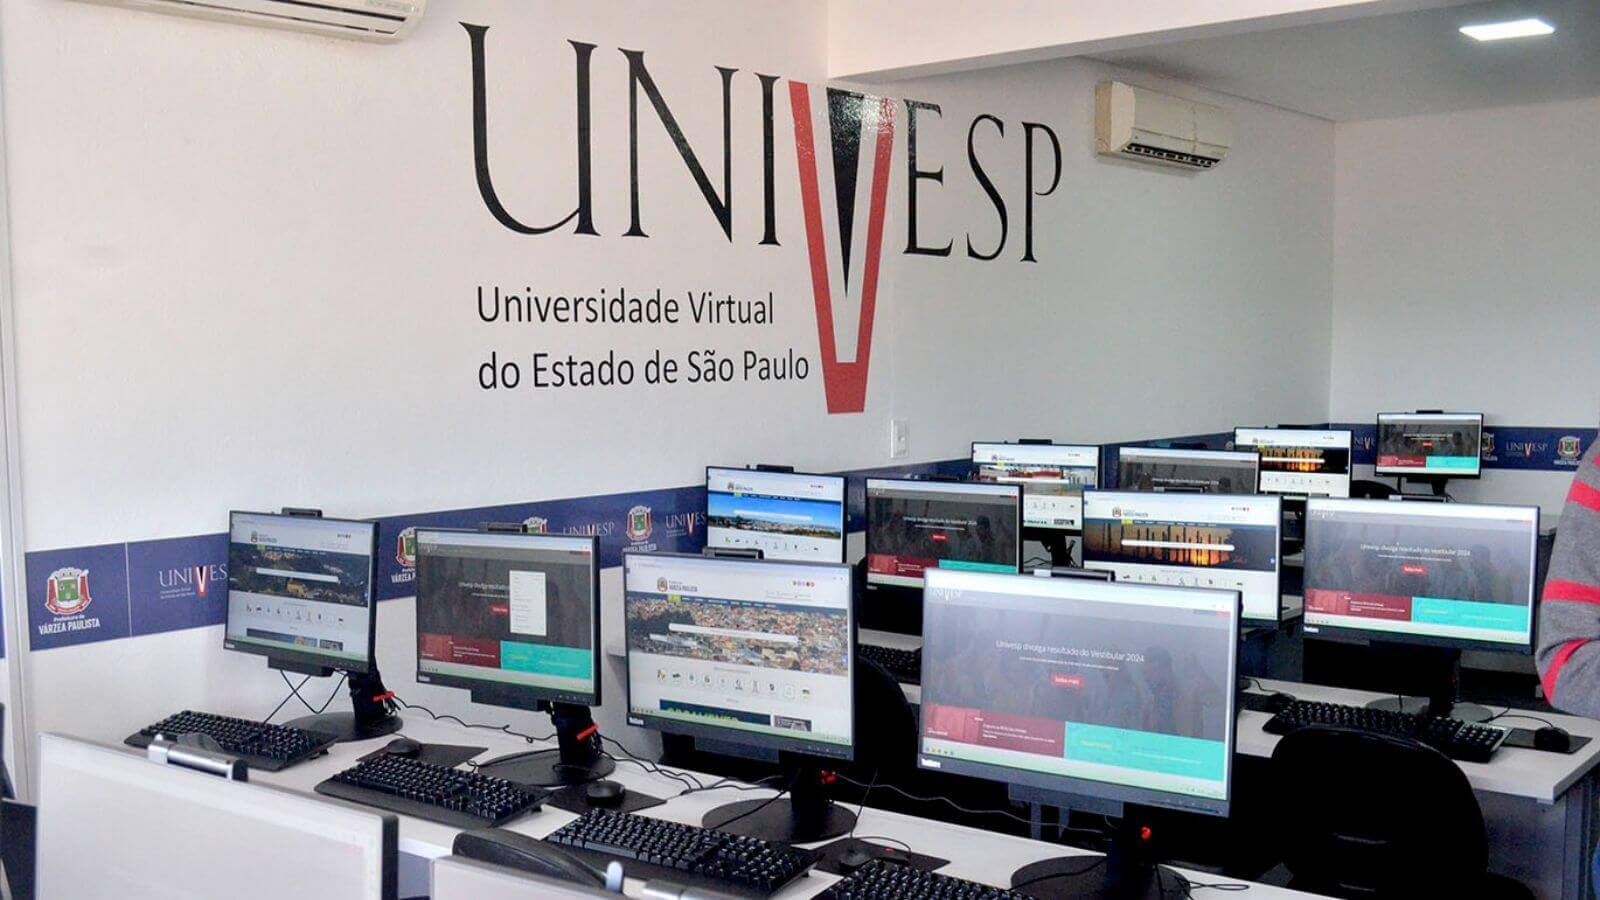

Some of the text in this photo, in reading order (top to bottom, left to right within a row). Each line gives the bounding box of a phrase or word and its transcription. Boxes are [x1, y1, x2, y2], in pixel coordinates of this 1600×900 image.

[459, 22, 1062, 414] UNIVESP
[477, 286, 773, 325] Universidade Virtual
[478, 349, 809, 390] do Estado de São Paulo
[666, 512, 705, 538] UNIVES
[159, 563, 228, 597] UNIVES
[38, 617, 101, 635] VÁRZEA PAULISTA
